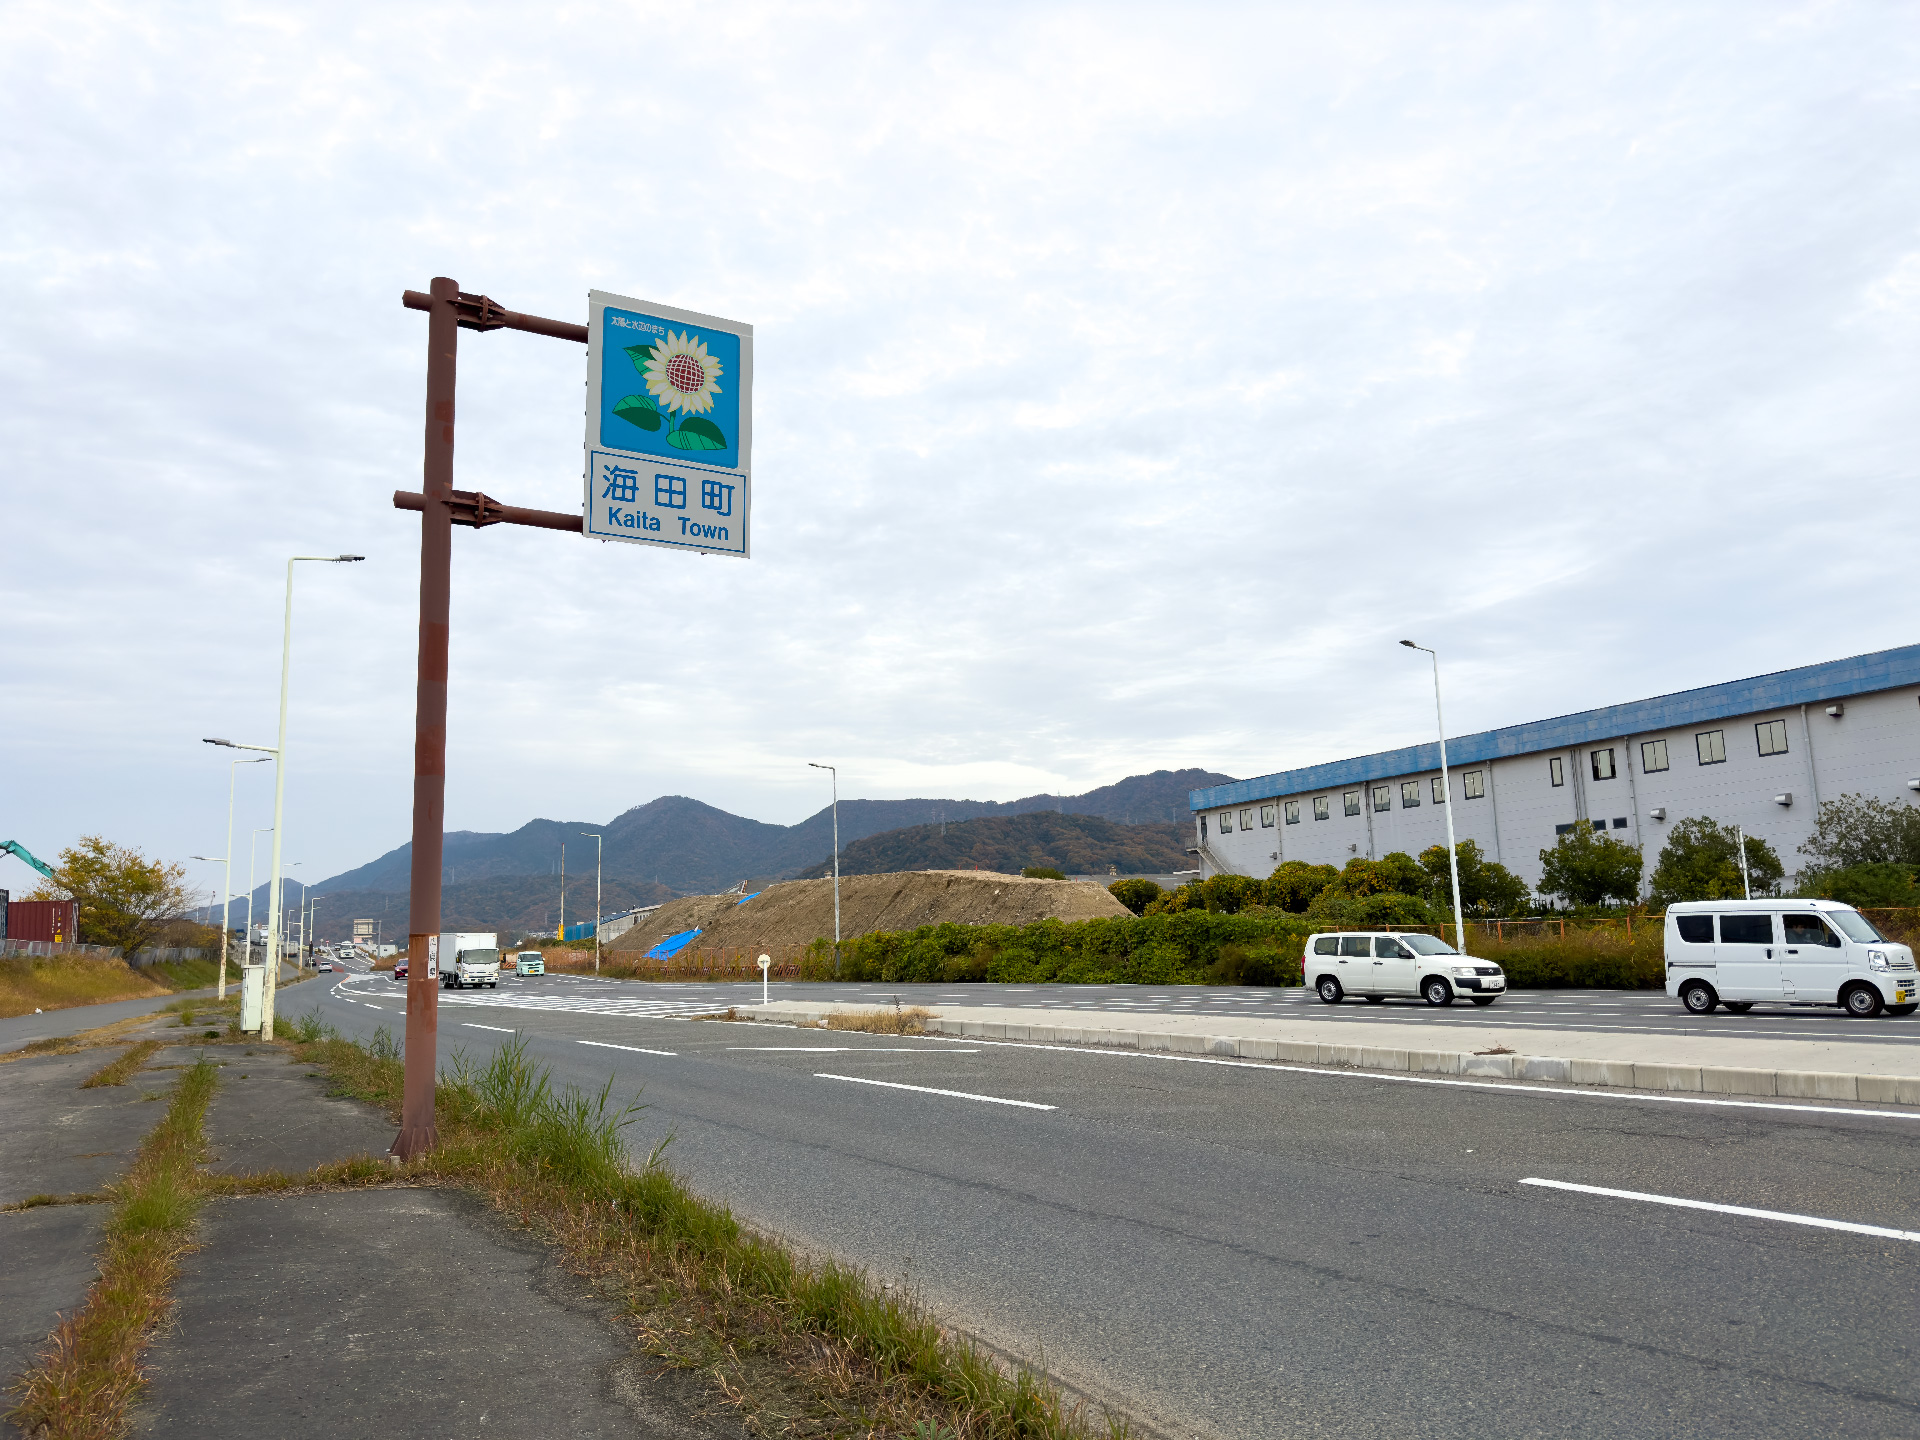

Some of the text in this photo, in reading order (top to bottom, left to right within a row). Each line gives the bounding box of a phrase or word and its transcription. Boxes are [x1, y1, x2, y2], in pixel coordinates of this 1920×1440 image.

[602, 464, 735, 517] 海田町
[608, 506, 729, 541] Kaita Town
